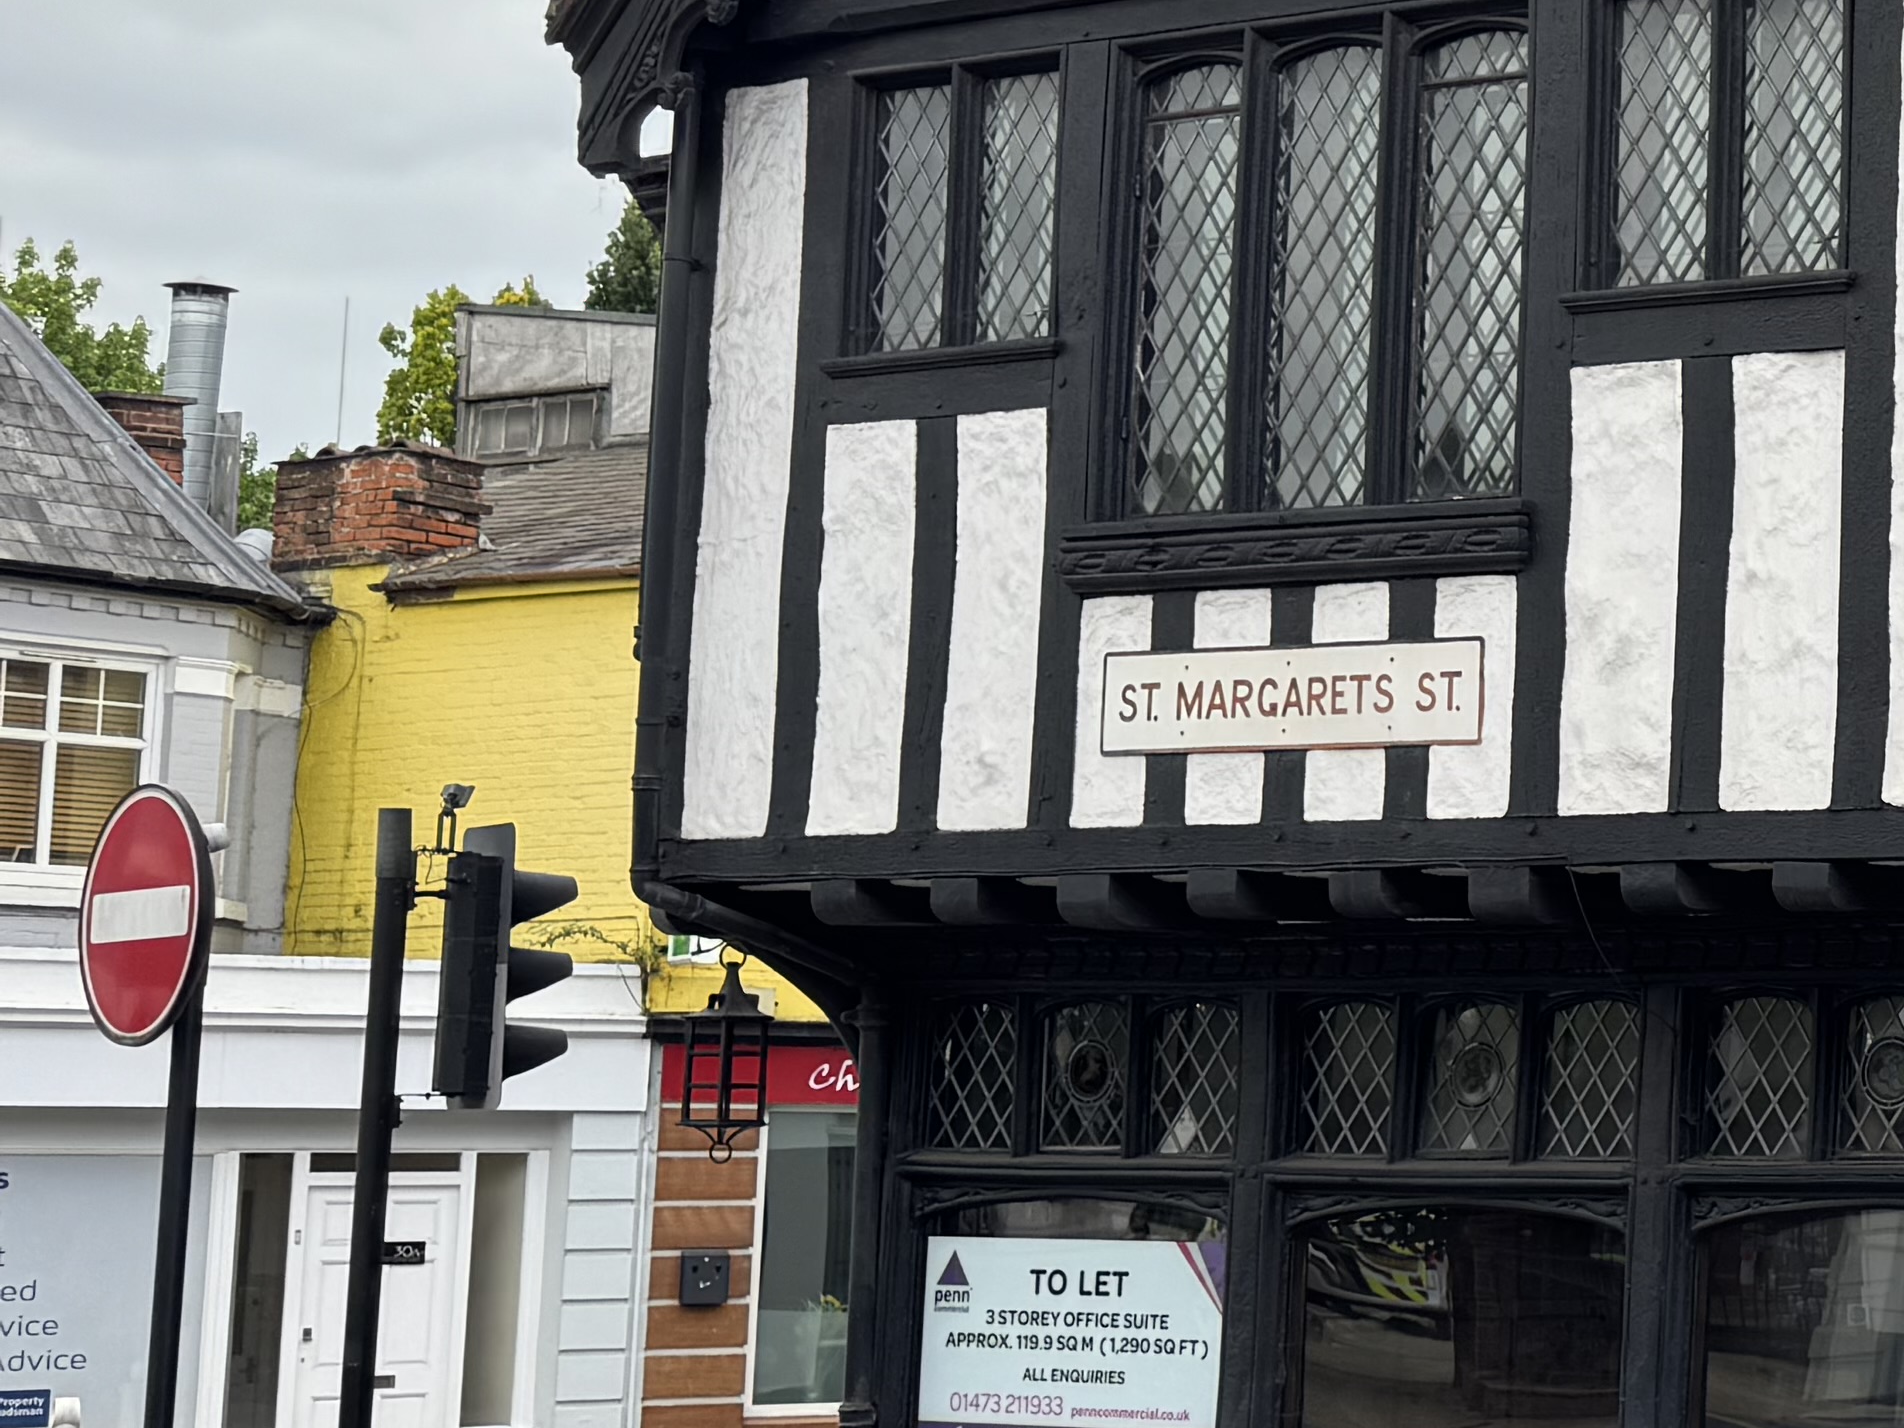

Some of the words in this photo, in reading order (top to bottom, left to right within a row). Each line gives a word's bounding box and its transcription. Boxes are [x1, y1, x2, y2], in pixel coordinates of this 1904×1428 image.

[1118, 682, 1160, 723] ST.
[1175, 672, 1395, 721] MARGARETS
[1415, 670, 1463, 713] ST.
[1029, 1269, 1067, 1295] TO
[1080, 1270, 1129, 1297] LET
[934, 1289, 970, 1307] penn
[985, 1309, 995, 1325] 3
[998, 1310, 1061, 1327] STOREY
[1063, 1311, 1120, 1328] OFFICE
[1123, 1313, 1169, 1330] SUITE
[945, 1332, 1013, 1349] APPROX.
[1016, 1334, 1053, 1350] 119.9
[1056, 1335, 1078, 1352] SQ
[1081, 1336, 1094, 1352] M
[1153, 1338, 1176, 1355] SQ
[1023, 1367, 1047, 1382] ALL
[1050, 1368, 1126, 1385] ENQUIRIES
[950, 1392, 1001, 1413] 01473
[1005, 1394, 1064, 1416] 211933
